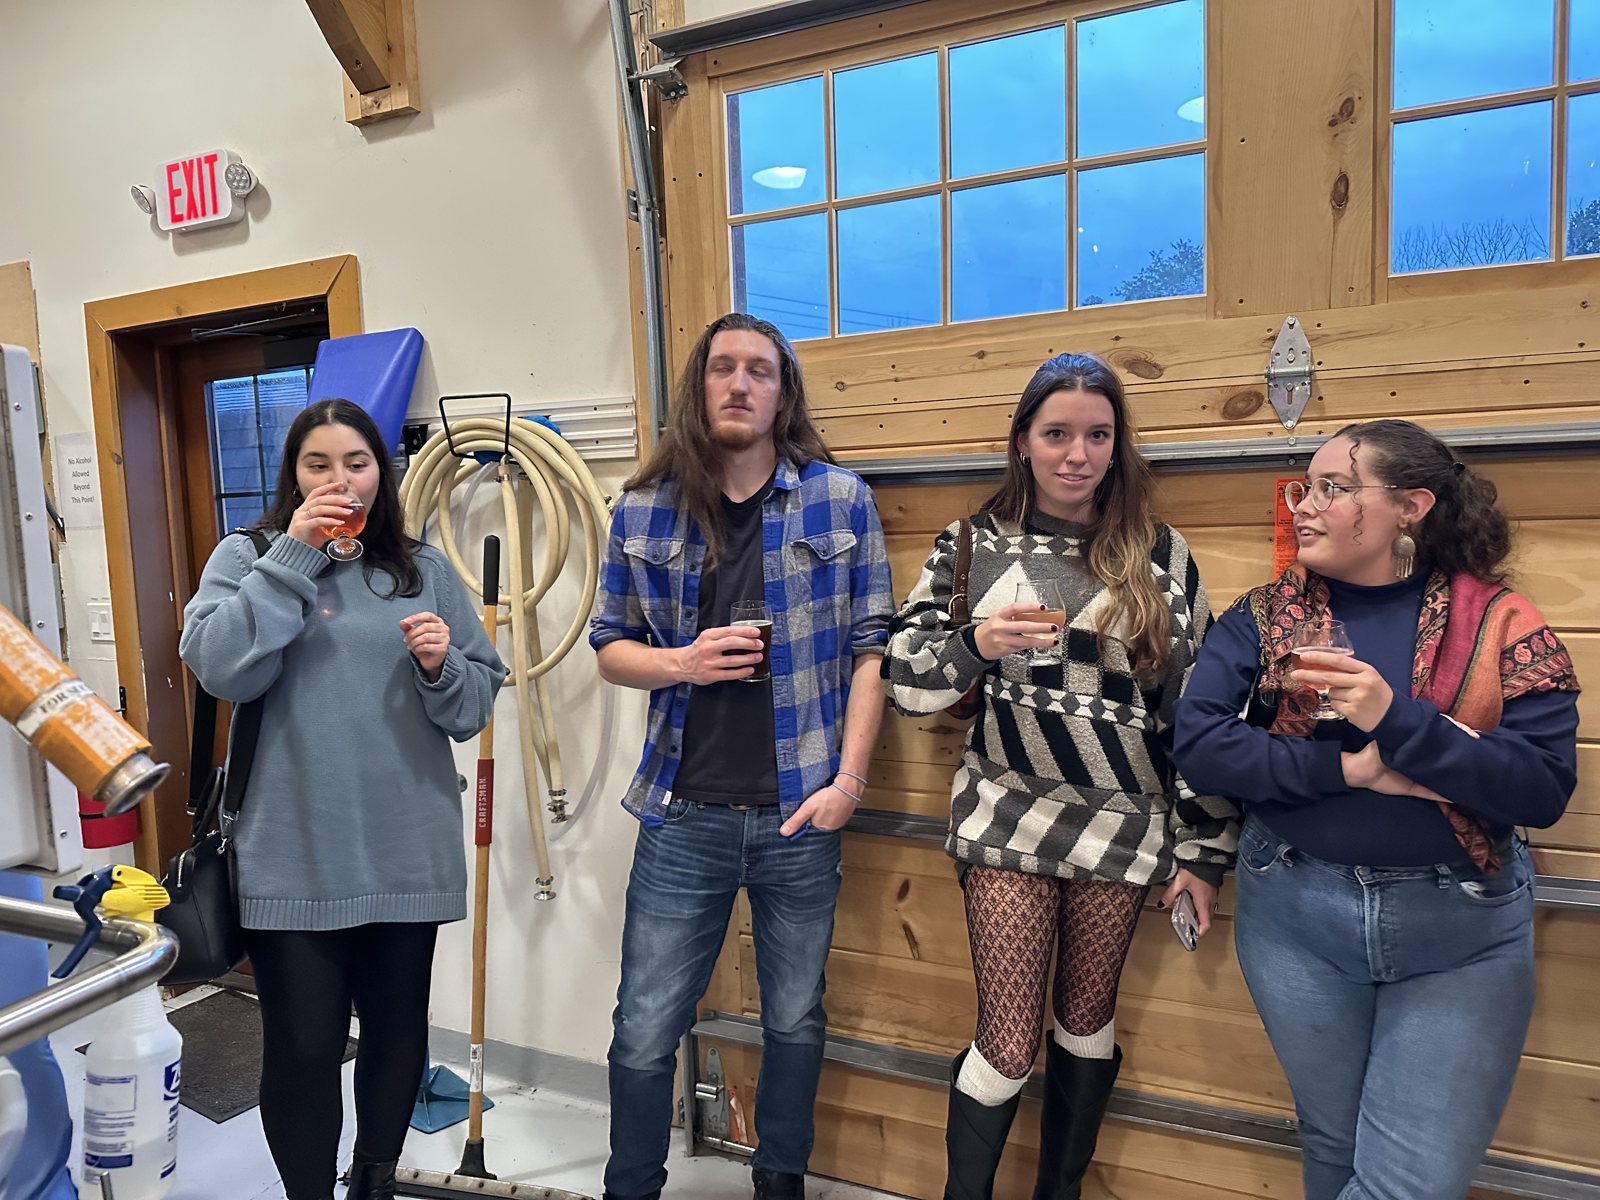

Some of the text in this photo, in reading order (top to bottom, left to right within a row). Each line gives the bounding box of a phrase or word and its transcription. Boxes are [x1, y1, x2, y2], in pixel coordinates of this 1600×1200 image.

[166, 153, 219, 224] EXIT
[75, 456, 92, 464] Alcohol
[72, 470, 90, 478] Allowed
[73, 483, 91, 491] Beyond
[71, 495, 95, 504] This Point!
[478, 778, 487, 828] CRAFTSMAN
